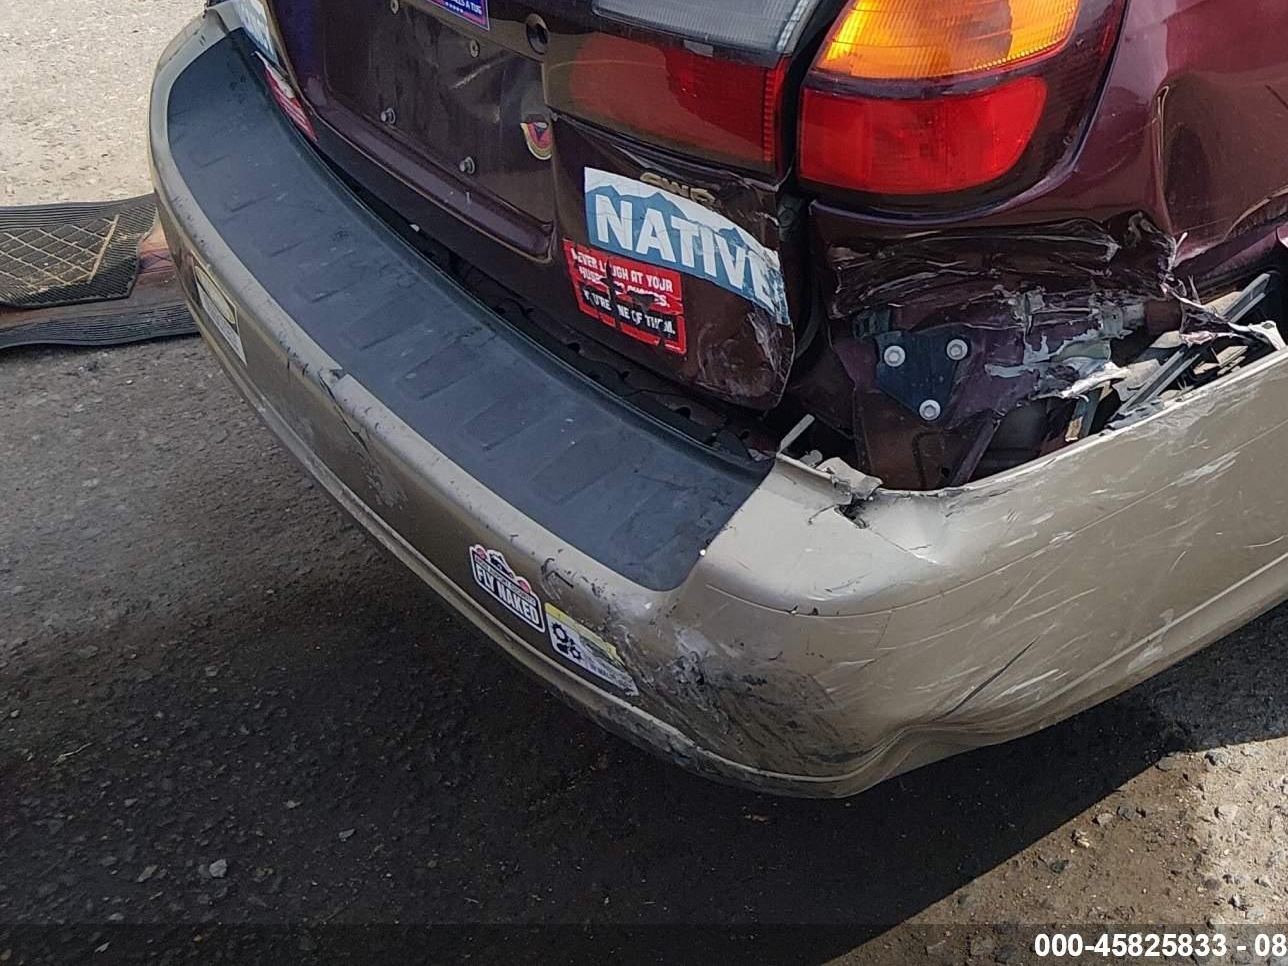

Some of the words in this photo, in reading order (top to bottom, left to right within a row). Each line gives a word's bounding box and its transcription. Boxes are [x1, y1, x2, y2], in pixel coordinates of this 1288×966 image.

[629, 270, 644, 285] AT
[475, 564, 496, 593] FLY
[496, 580, 540, 626] NAKED
